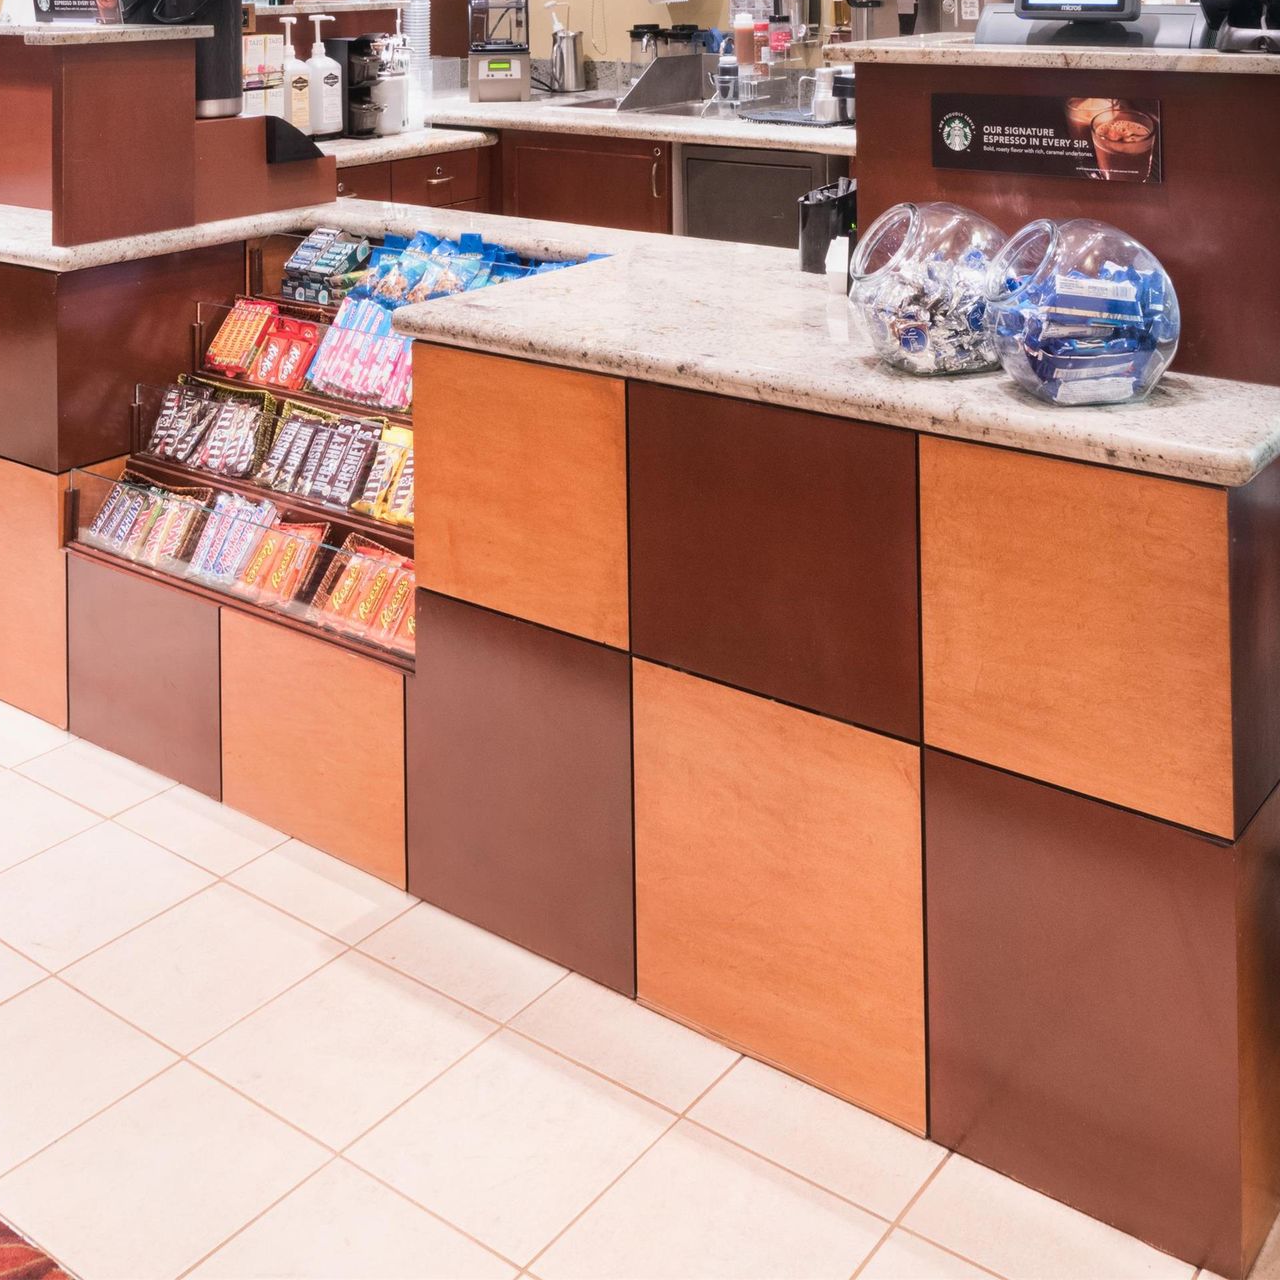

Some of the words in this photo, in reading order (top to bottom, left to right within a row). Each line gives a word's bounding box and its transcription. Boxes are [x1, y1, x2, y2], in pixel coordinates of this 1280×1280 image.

[1061, 4, 1082, 12] micros
[983, 125, 1002, 134] OUR
[1004, 126, 1055, 137] SIGNATURE
[983, 135, 1027, 145] ESPRESSO
[1029, 137, 1040, 146] IN
[1042, 138, 1071, 148] EVERY
[1073, 139, 1090, 149] SIP.
[359, 572, 386, 620] Reese's
[381, 580, 408, 629] Reese's
